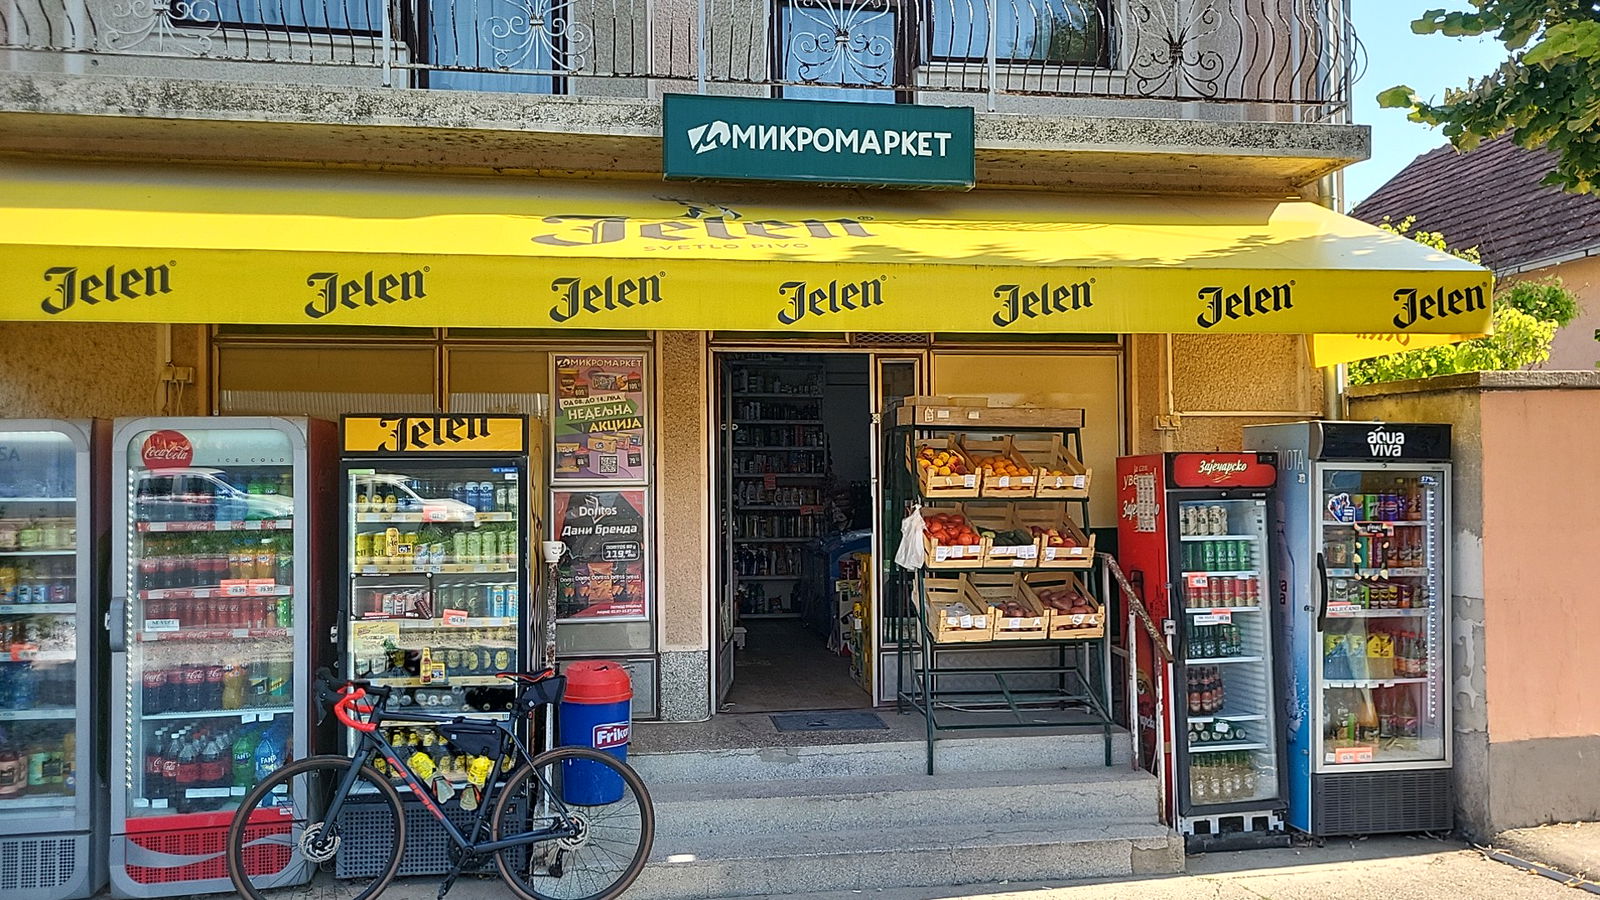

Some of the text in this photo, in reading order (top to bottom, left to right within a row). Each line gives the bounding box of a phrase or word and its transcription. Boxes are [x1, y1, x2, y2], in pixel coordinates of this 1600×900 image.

[732, 123, 952, 157] МИКРОМАРКЕТ
[531, 214, 879, 247] Jelen
[643, 243, 739, 251] SVETLO
[41, 261, 173, 315] Jelen
[304, 267, 427, 319] Jelen
[549, 270, 663, 325] Jelen
[777, 276, 885, 326] Jelen
[992, 280, 1094, 328] Jelen
[1196, 282, 1294, 328] Jelen
[1392, 283, 1487, 330] Jelen
[570, 358, 642, 368] МИКРОМАРКЕТ
[585, 397, 595, 405] ДО
[568, 404, 632, 420] НЕДЕЉНА
[377, 417, 491, 451] Jelen
[589, 418, 642, 433] АКЦИЈА
[144, 445, 190, 460] Coca-Cola
[1369, 443, 1402, 457] viva
[1198, 459, 1248, 474] Зајечарско
[579, 505, 618, 516] Doritos
[562, 524, 637, 537] Дани Бренда
[596, 727, 629, 745] Friko
